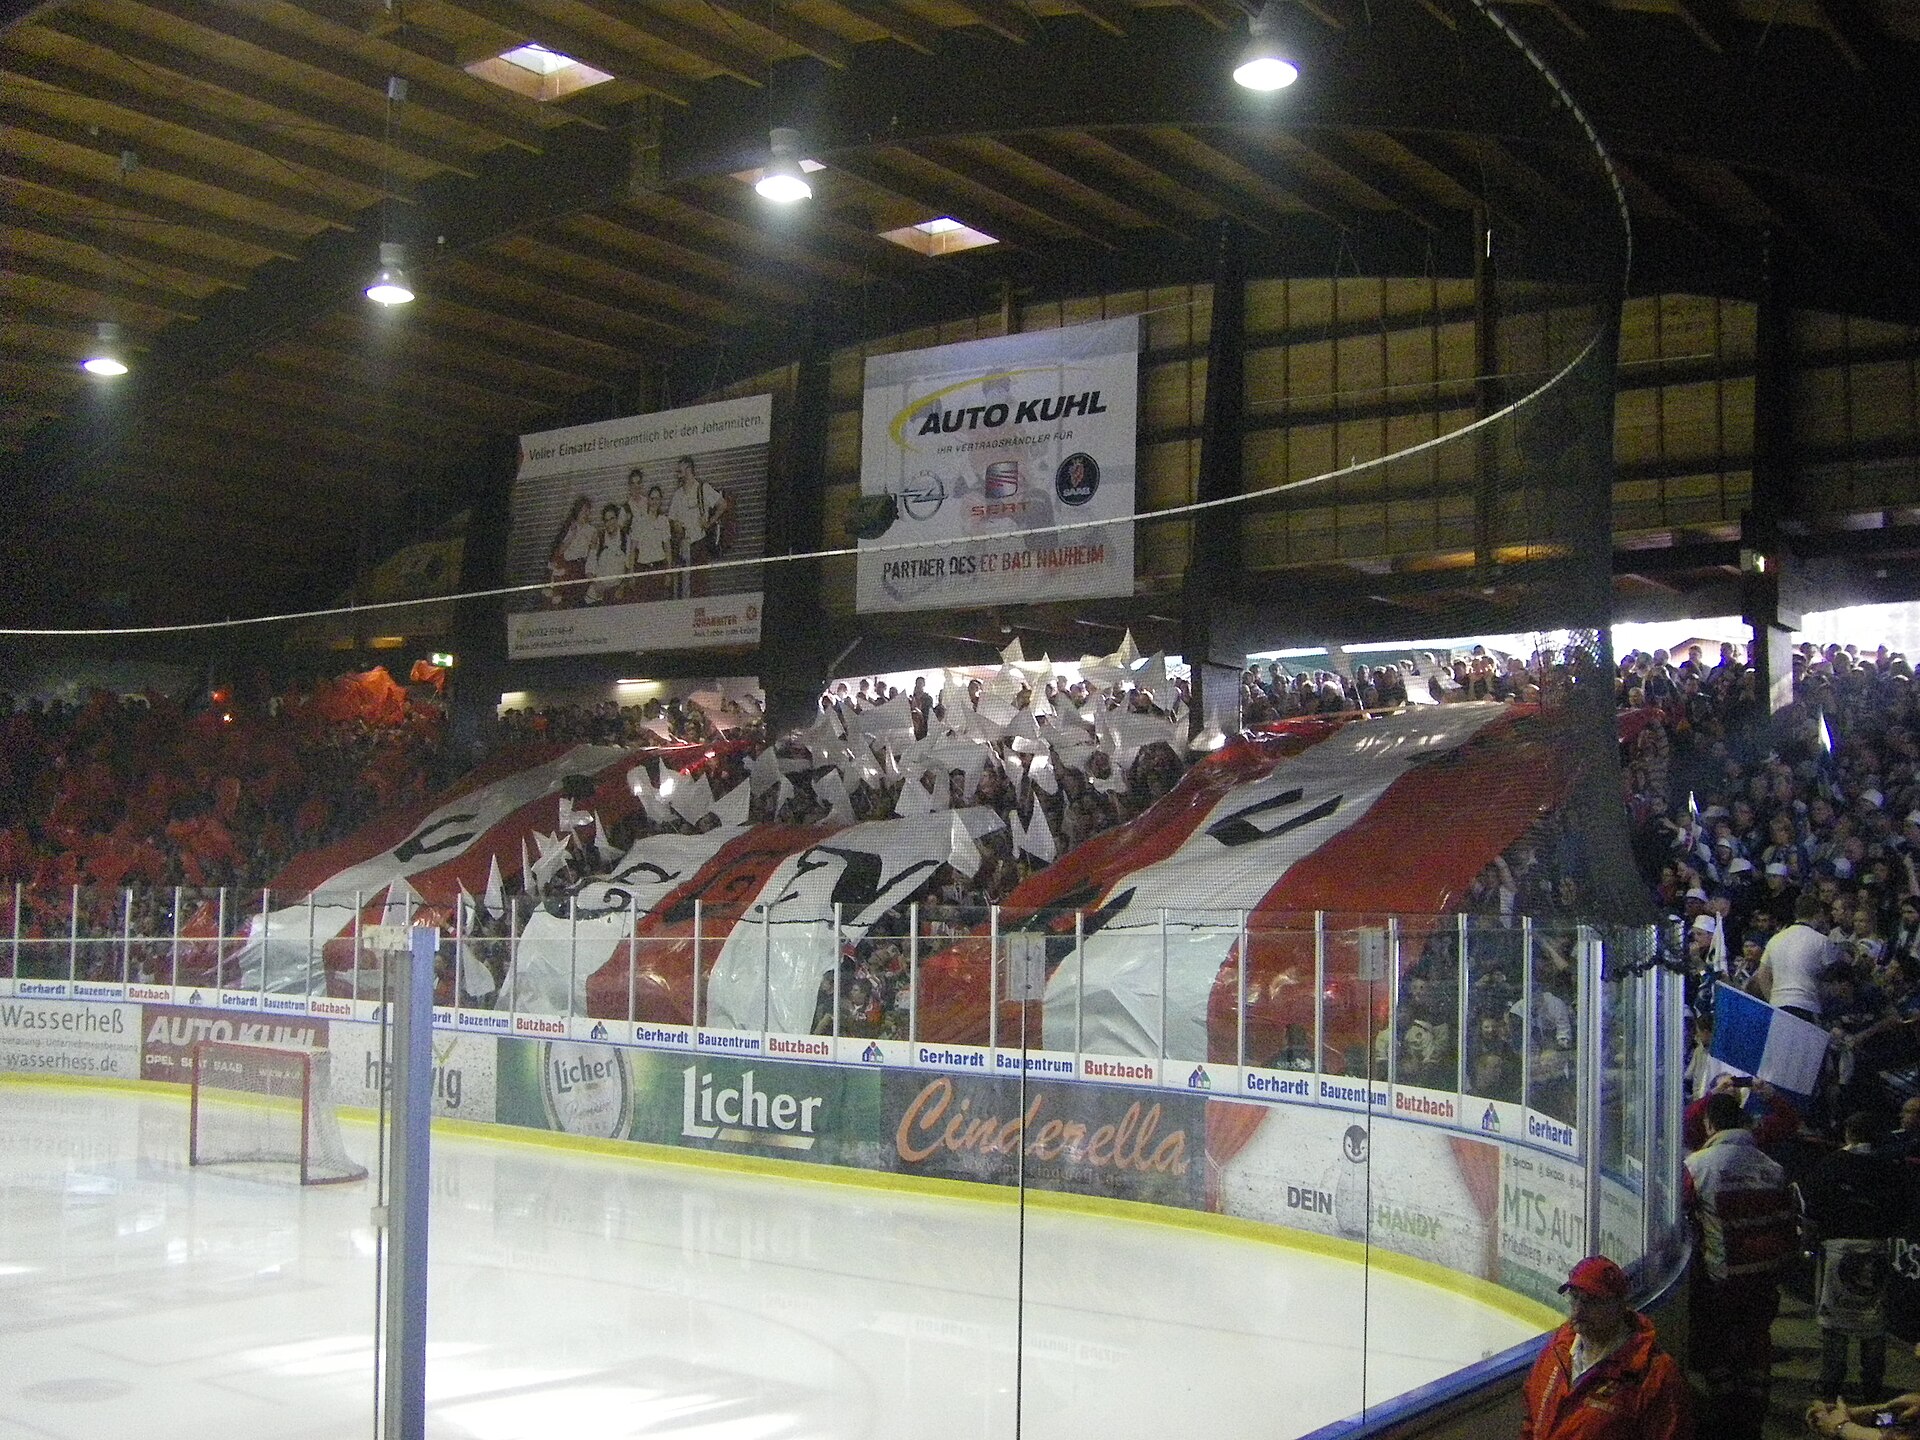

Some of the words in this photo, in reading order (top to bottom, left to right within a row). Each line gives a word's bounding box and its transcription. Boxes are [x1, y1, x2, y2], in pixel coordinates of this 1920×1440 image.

[918, 404, 1009, 436] AUTO
[1014, 390, 1107, 425] KUHL
[529, 448, 555, 462] Voller
[559, 438, 596, 457] Einsatz!
[598, 430, 660, 450] Ehrenamtlich
[663, 427, 678, 441] bei
[680, 424, 699, 438] den
[701, 413, 765, 434] Johannitern.
[937, 445, 953, 455] IHR
[1053, 430, 1074, 442] FÜR
[883, 557, 945, 580] PARTNER
[949, 555, 977, 576] DES
[980, 553, 999, 573] EC
[1002, 550, 1033, 572] BAD
[1036, 545, 1105, 568] NAUHEIM
[19, 982, 67, 996] Gerhardt
[73, 984, 123, 998] Bauzentrum
[128, 987, 171, 1001] Butzbach
[222, 993, 259, 1008] Gerhardt
[263, 996, 306, 1011] Bauzentrum
[310, 1001, 352, 1016] Butzbach
[1, 1005, 124, 1035] Wasserheß
[146, 1015, 233, 1046] AUTO
[458, 1013, 509, 1029] Bauzentrum
[516, 1018, 565, 1034] Butzbach
[636, 1027, 690, 1045] Gerhardt
[697, 1032, 760, 1050] Bauzentrum
[769, 1037, 829, 1056] Butzbach
[145, 1054, 174, 1066] OPEL
[553, 1055, 614, 1094] Licher
[918, 1048, 985, 1068] Gerhardt
[996, 1052, 1074, 1074] Bauentrum
[1083, 1059, 1154, 1080] Butzbach
[682, 1065, 823, 1139] Licher
[1246, 1072, 1310, 1097] Gerhardt
[1320, 1080, 1388, 1107] Bauzentum
[1395, 1091, 1454, 1118] Butzbach
[896, 1076, 1190, 1176] Cinderella
[1528, 1115, 1574, 1148] Gerhardt
[1287, 1186, 1333, 1216] DEIN
[1503, 1183, 1547, 1237] MTS
[1377, 1203, 1443, 1241] HANDY
